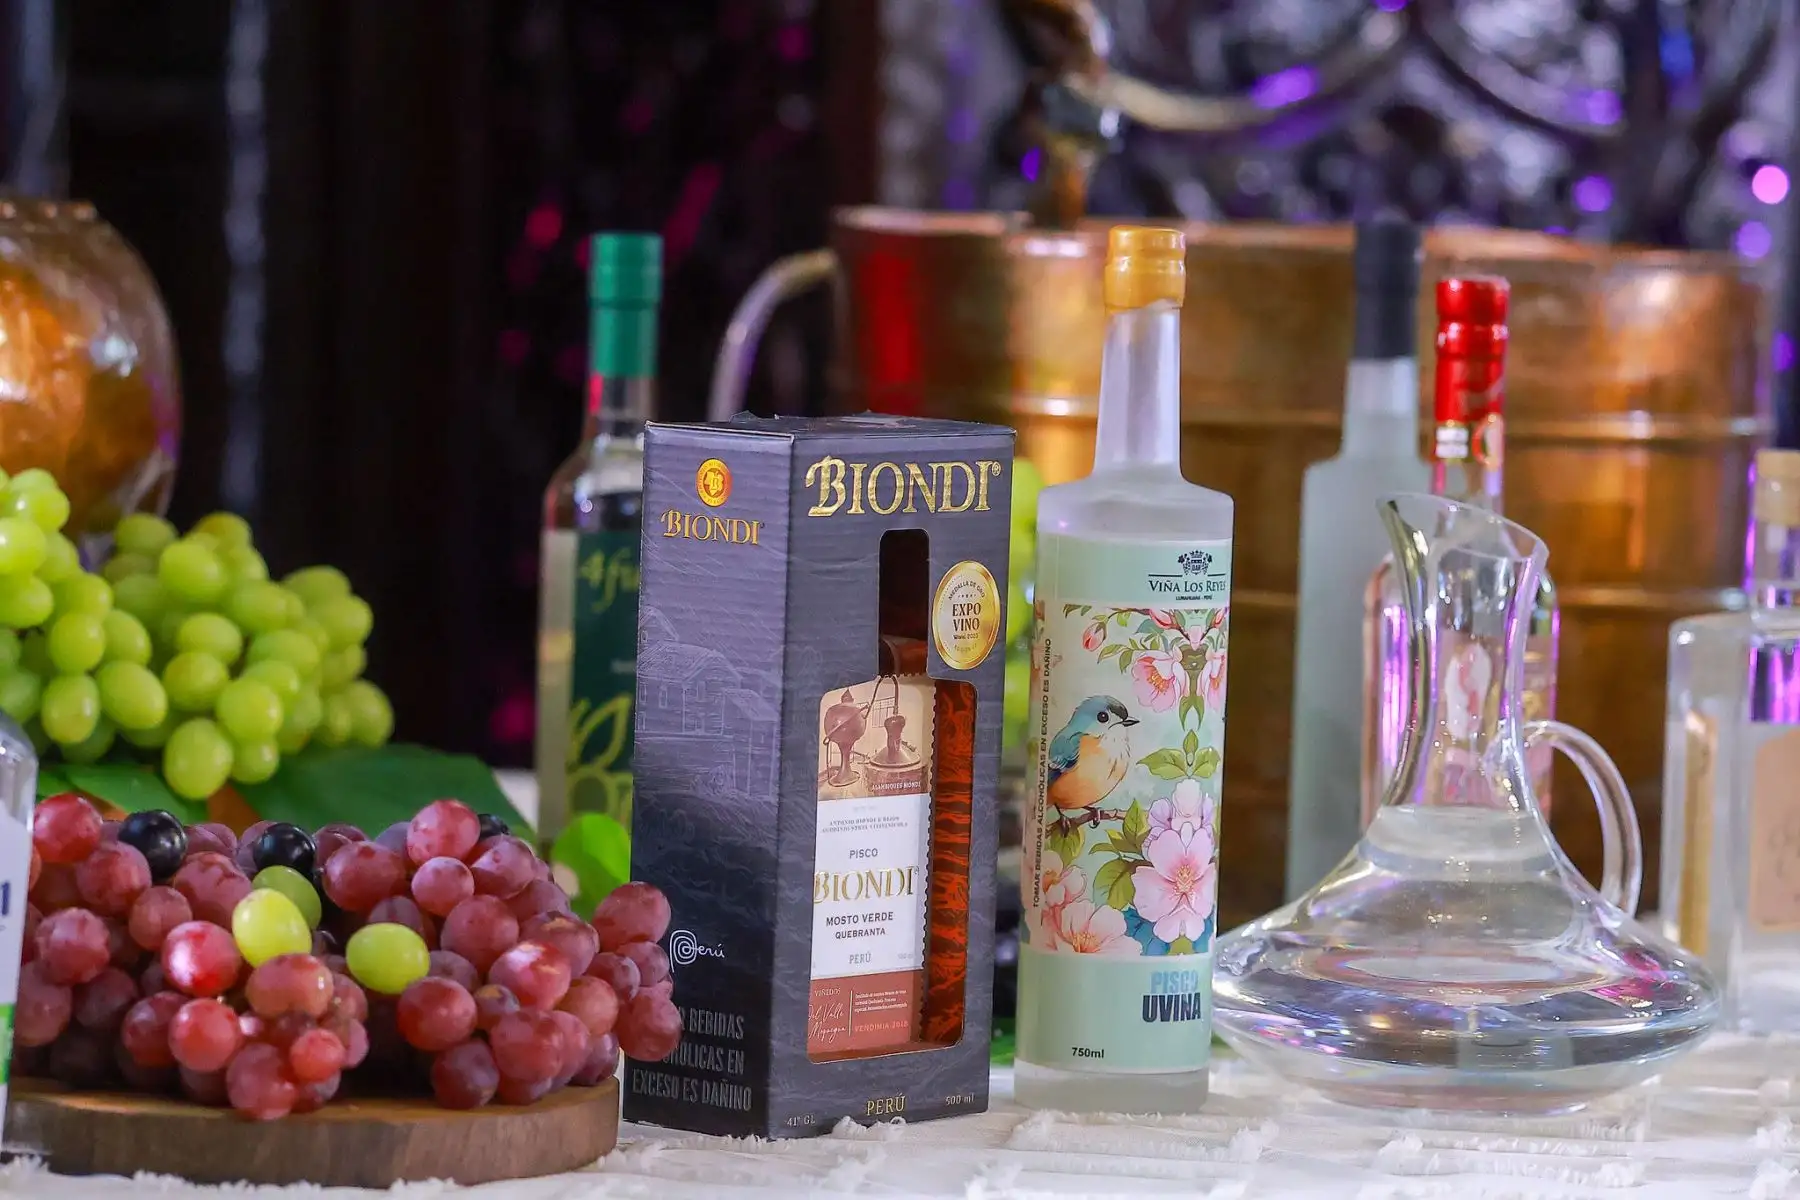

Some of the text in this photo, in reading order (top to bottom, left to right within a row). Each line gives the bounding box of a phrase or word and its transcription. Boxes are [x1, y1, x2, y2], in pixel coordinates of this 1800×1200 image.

[1148, 580, 1226, 592] VIÑA LOS REYES
[952, 602, 982, 617] EXPO
[953, 617, 980, 632] VINO
[1044, 638, 1052, 677] DAÑINO
[1043, 679, 1050, 693] ES
[1041, 695, 1049, 736] EXCESO
[1040, 737, 1047, 752] EN
[849, 847, 878, 859] PISCO
[1034, 828, 1043, 869] BEBIDAS
[1033, 871, 1041, 908] TOMAR
[826, 911, 894, 927] MOSTO VERDE
[835, 928, 886, 939] QUEBRANTA
[670, 930, 725, 973] Perú
[849, 951, 872, 964] PERÚ
[1150, 969, 1199, 994] PISCO
[1142, 992, 1202, 1023] UVINA
[689, 1007, 745, 1040] BEBIDAS
[854, 1022, 890, 1033] VENDIMIA
[1071, 1046, 1105, 1059] 750ml
[727, 1049, 745, 1076] EN
[632, 1068, 752, 1112] EXCESO ES DAÑINO
[866, 1093, 906, 1116] PERÚ
[945, 1094, 962, 1106] 500
[803, 1114, 816, 1126] GL
